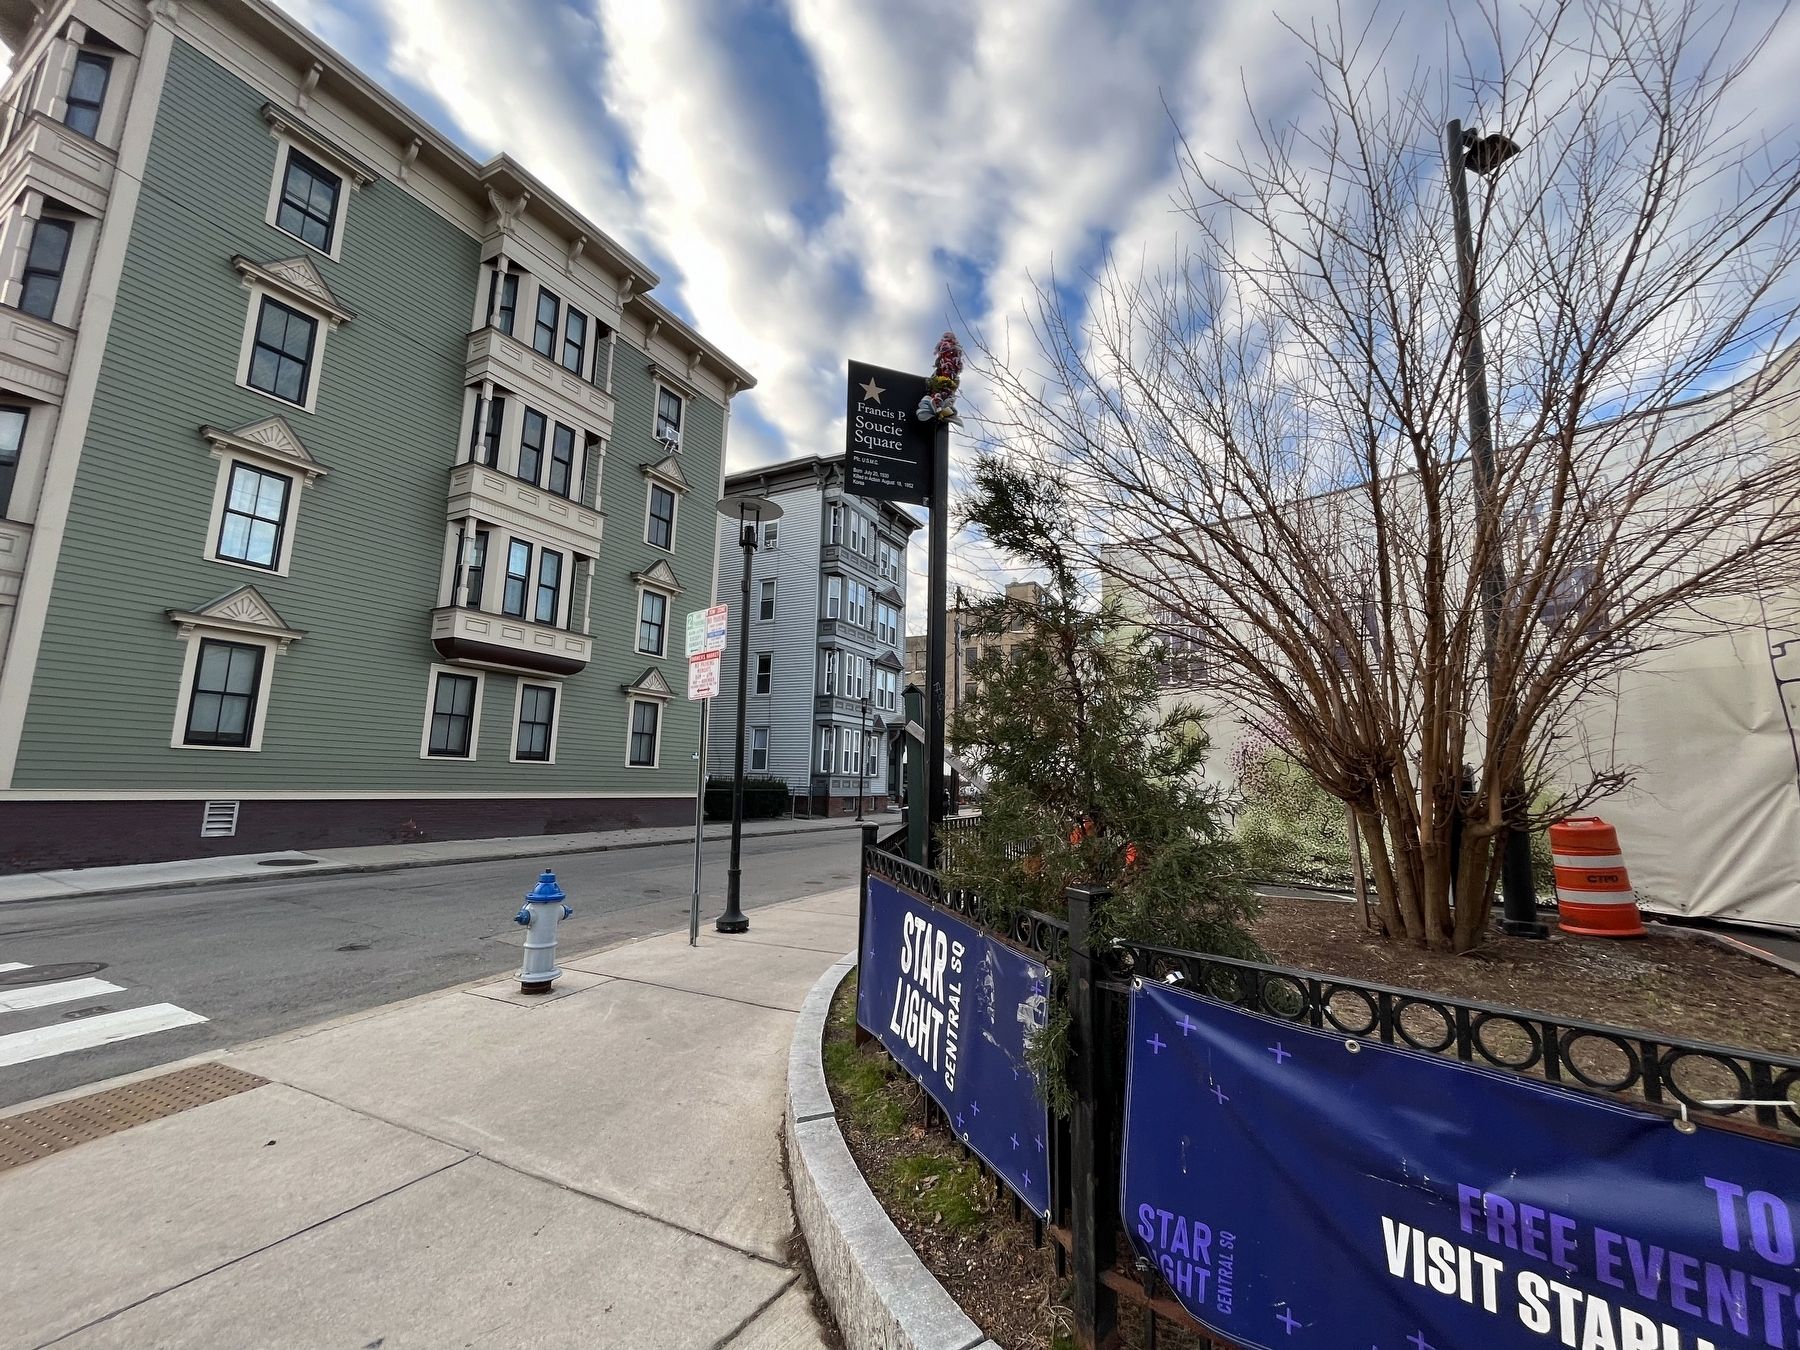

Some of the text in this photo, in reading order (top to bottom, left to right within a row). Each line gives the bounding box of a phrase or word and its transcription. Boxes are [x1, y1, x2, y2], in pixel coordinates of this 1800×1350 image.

[854, 430, 903, 450] Square
[855, 415, 903, 437] Soucie
[857, 402, 907, 422] Francis P.
[901, 911, 947, 1005] STAR
[951, 940, 966, 973] SQ
[890, 977, 945, 1072] LIGHT
[945, 983, 962, 1093] CENTRAL
[1137, 1202, 1212, 1266] STAR
[1219, 1230, 1236, 1250] SQ
[1704, 1176, 1796, 1266] TO
[1150, 1248, 1212, 1304] GHT
[1216, 1253, 1234, 1315] CENTRAL
[1381, 1215, 1715, 1350] VISIT STAR
[1457, 1182, 1800, 1350] FREE EVENT
